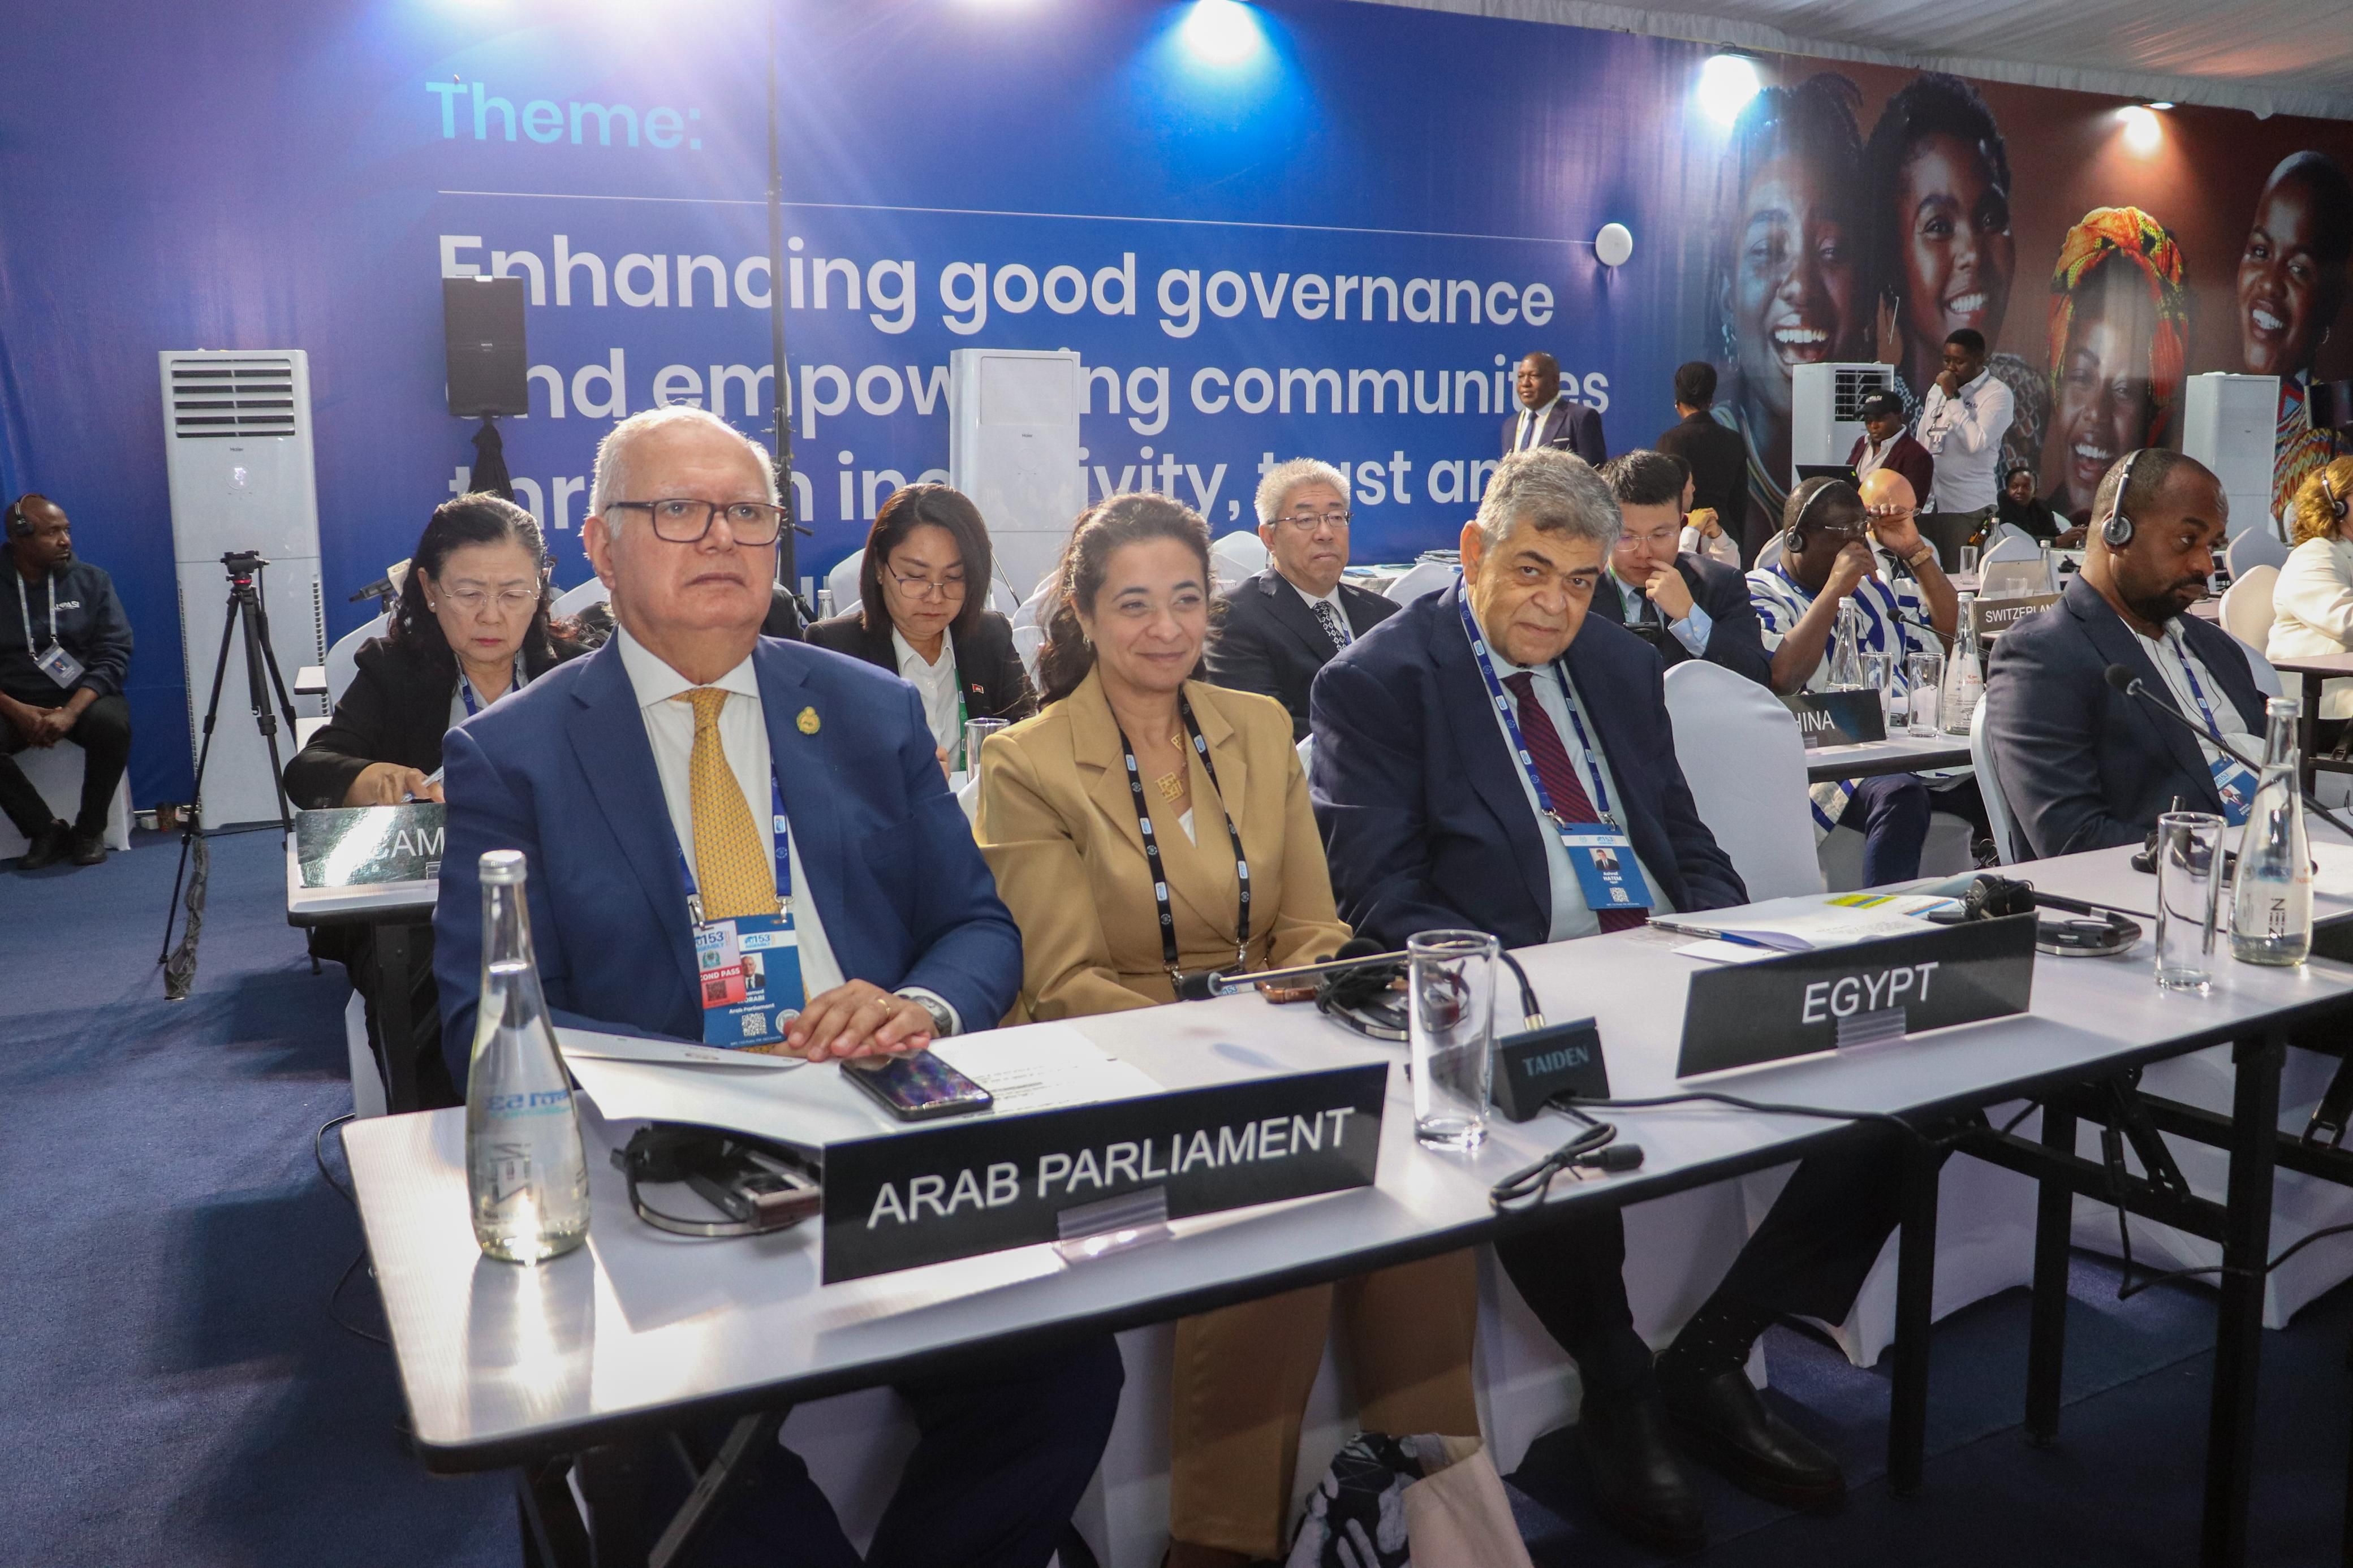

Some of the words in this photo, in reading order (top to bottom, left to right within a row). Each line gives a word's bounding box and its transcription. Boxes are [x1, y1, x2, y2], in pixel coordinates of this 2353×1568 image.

[426, 81, 701, 150] Theme:
[439, 234, 916, 334] Enhancing
[939, 252, 1136, 335] good
[1157, 268, 1554, 338] governance
[446, 348, 626, 420] nd
[1191, 353, 1609, 414] communites
[1795, 710, 1836, 732] HINA
[721, 967, 740, 977] PASS
[1802, 962, 1940, 1023] EGYPT
[743, 1003, 775, 1012] Parliament
[1523, 1046, 1589, 1076] TAIDEN
[867, 1163, 1020, 1230] ARAB
[1037, 1107, 1355, 1198] PARLIAMENT
